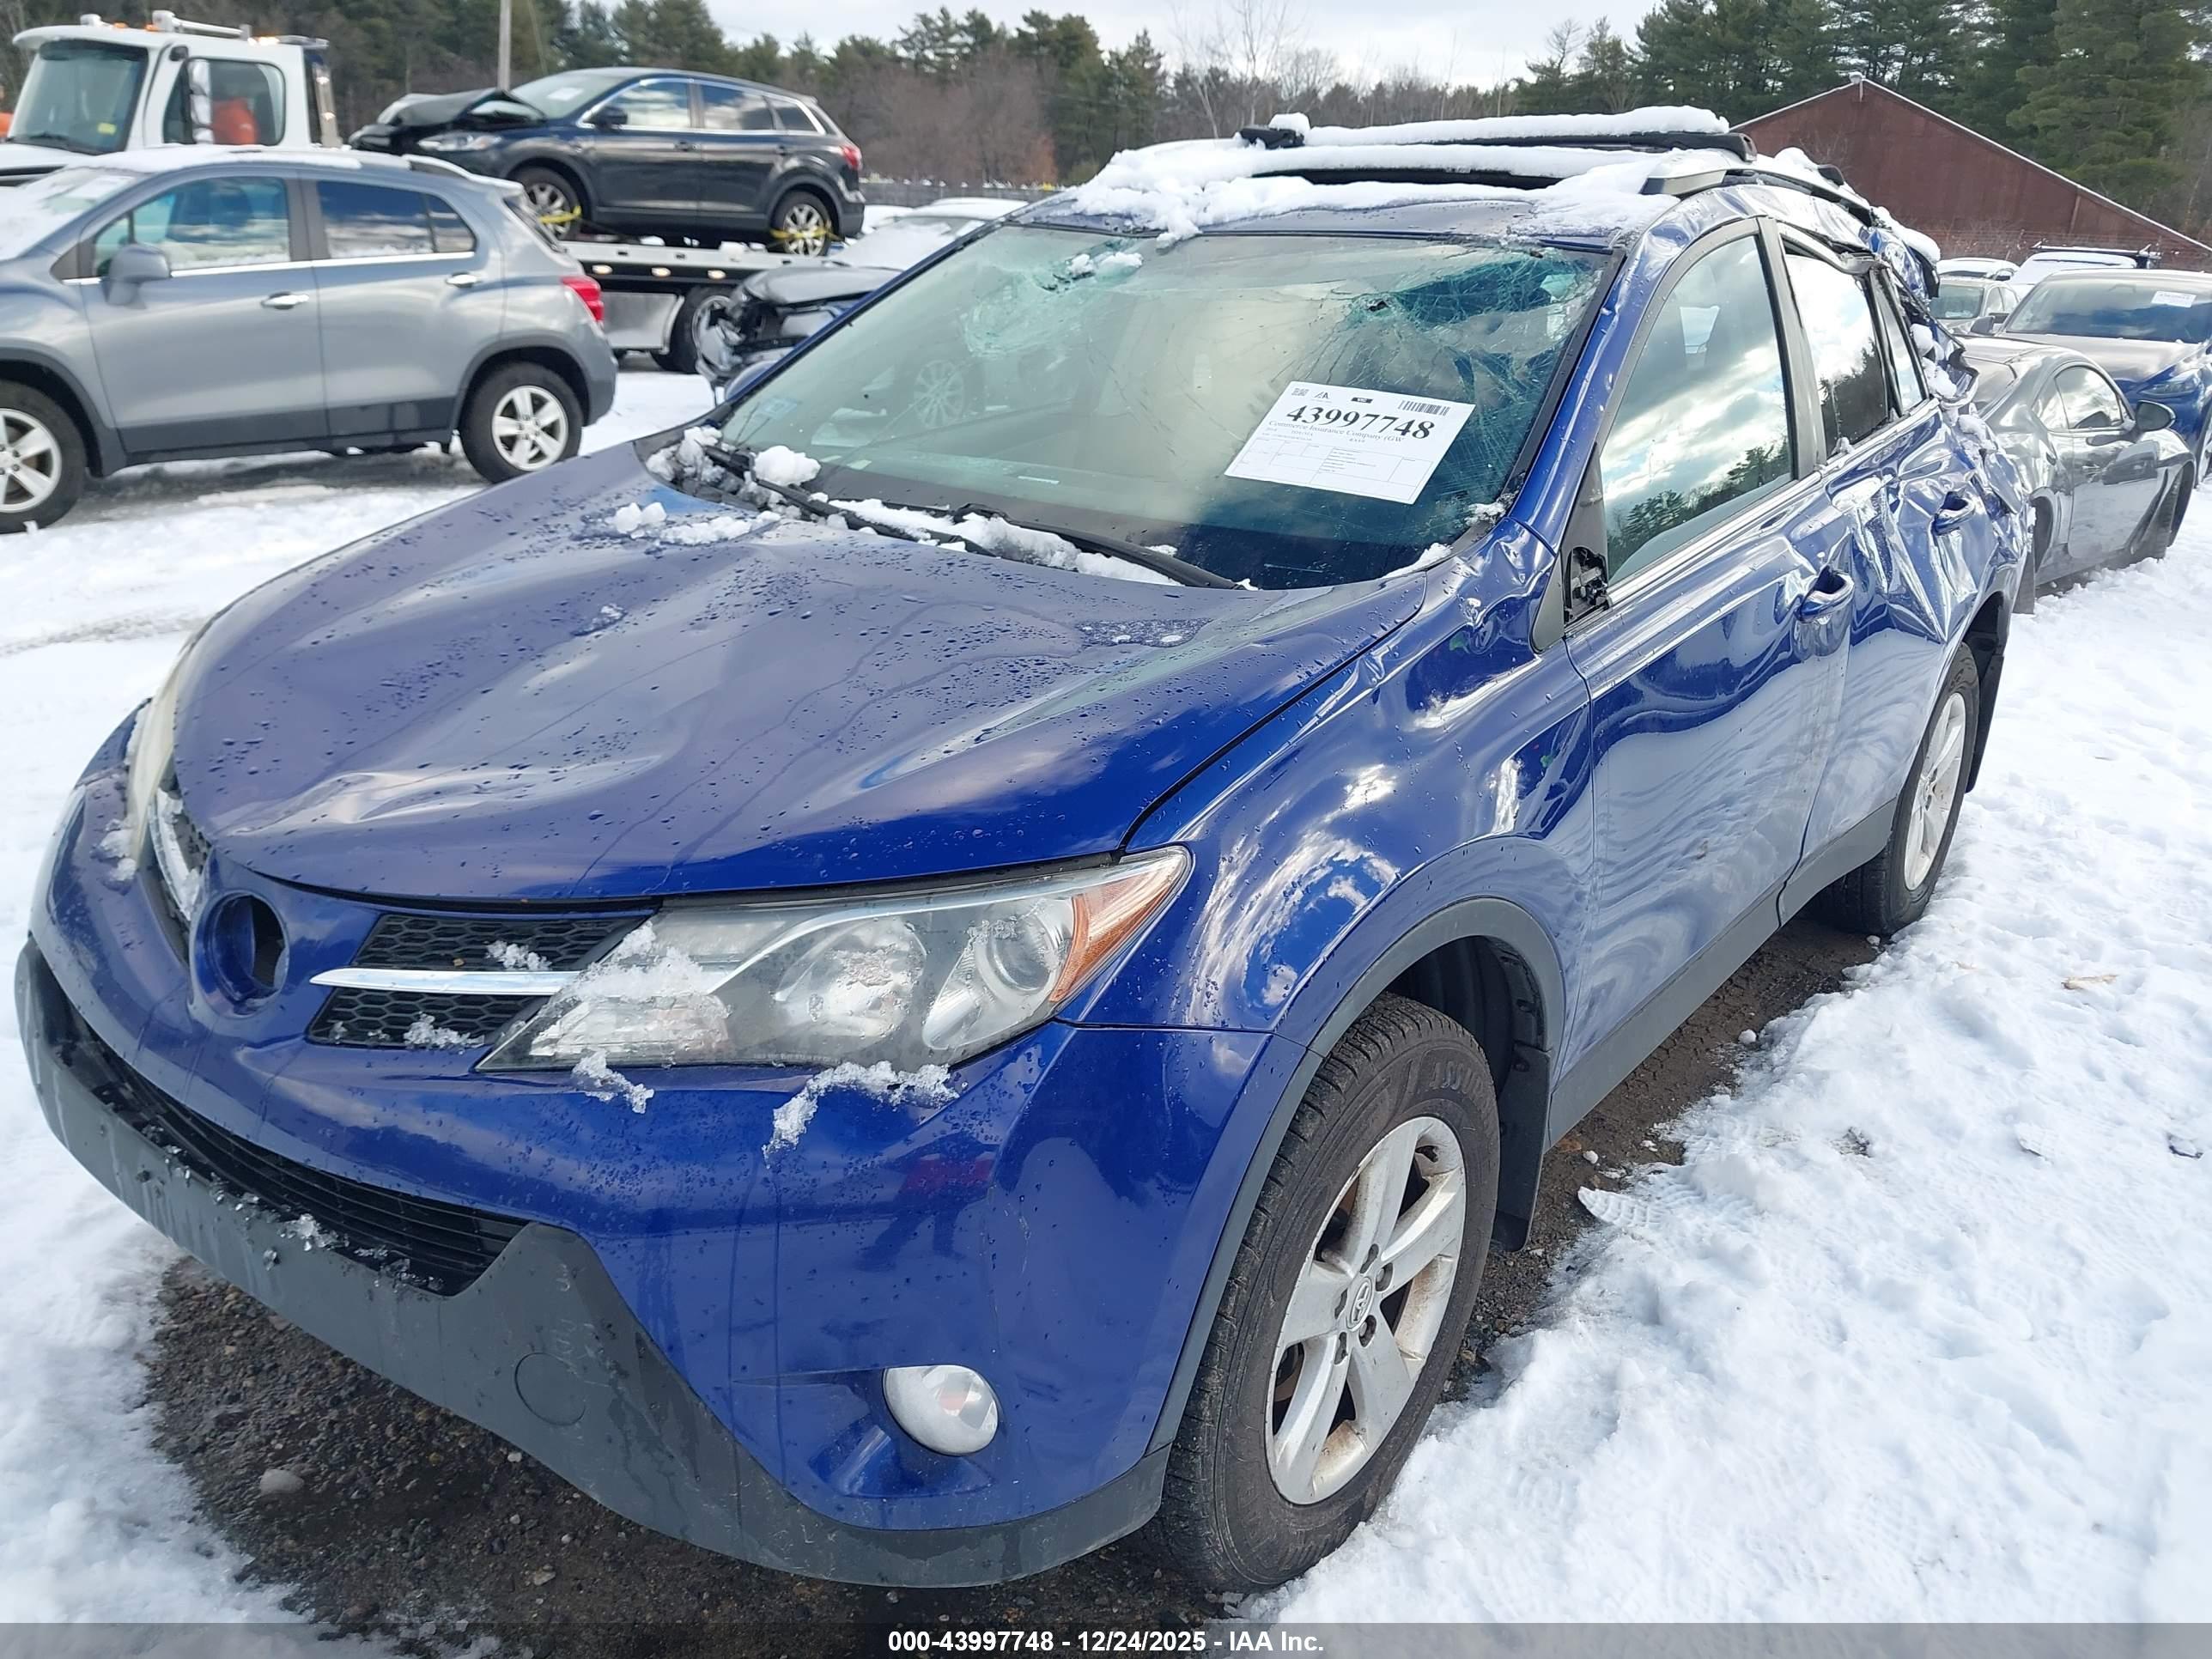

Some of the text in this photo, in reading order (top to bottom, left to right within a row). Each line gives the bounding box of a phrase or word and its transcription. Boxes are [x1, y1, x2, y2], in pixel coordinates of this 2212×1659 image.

[1286, 404, 1435, 439] 43997748
[1309, 425, 1345, 435] Insurance
[1346, 429, 1381, 440] Company
